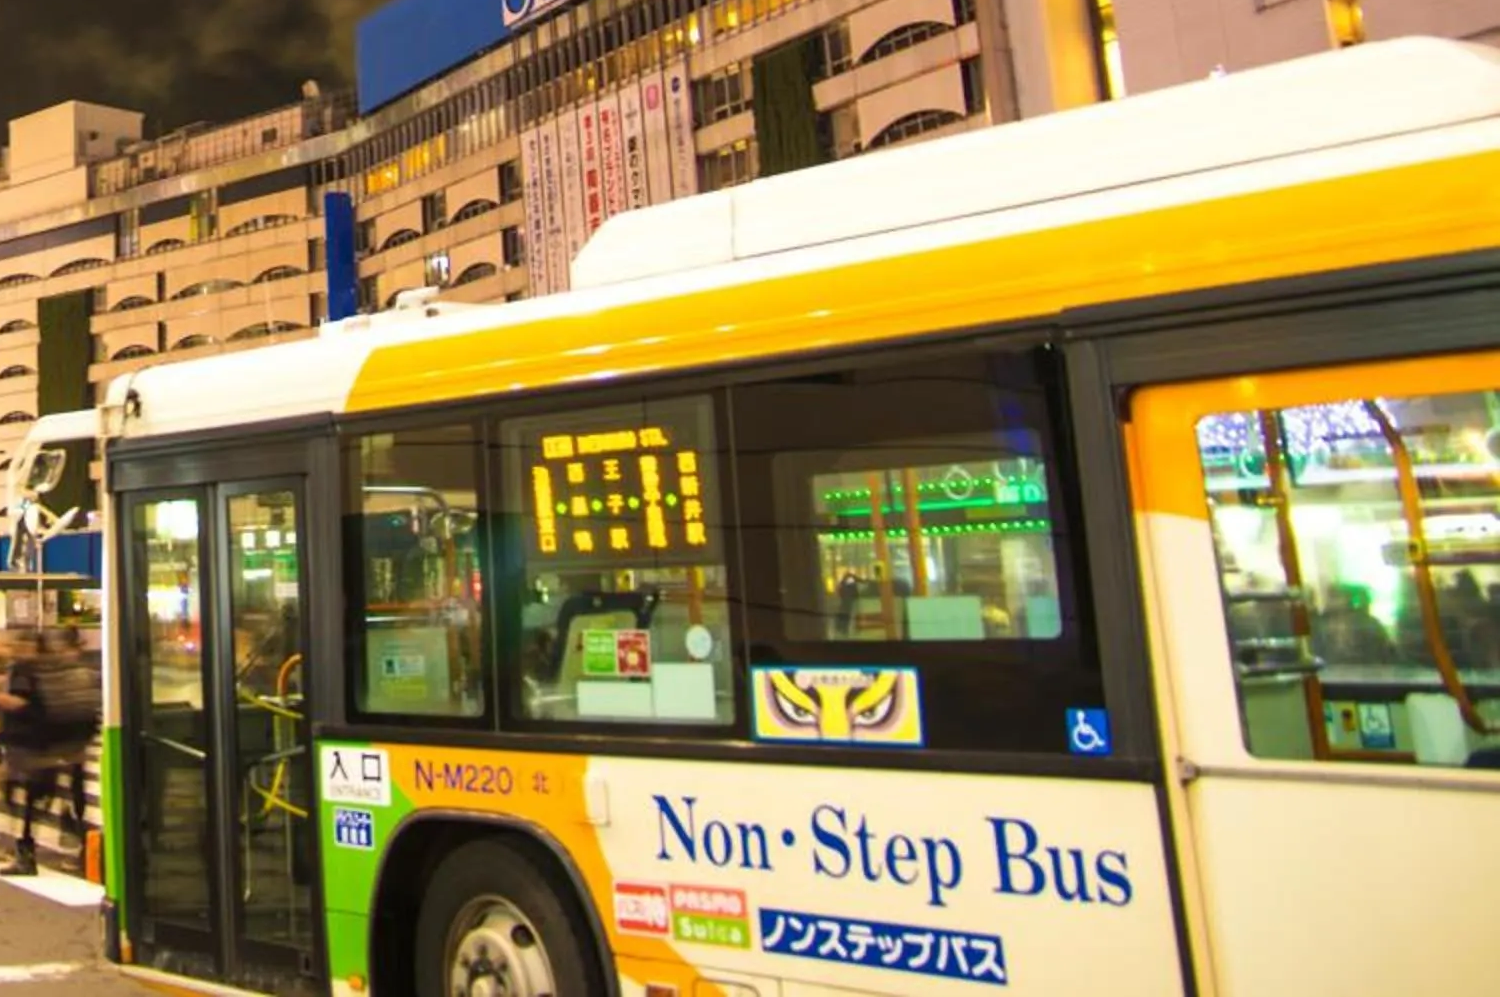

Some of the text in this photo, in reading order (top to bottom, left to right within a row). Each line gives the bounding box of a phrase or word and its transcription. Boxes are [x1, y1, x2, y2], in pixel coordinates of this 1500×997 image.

[330, 751, 382, 782] 入口
[414, 759, 514, 795] N-M220
[985, 815, 1133, 907] Bus
[679, 915, 743, 944] Suica
[763, 913, 1005, 981] ノンステップバス
